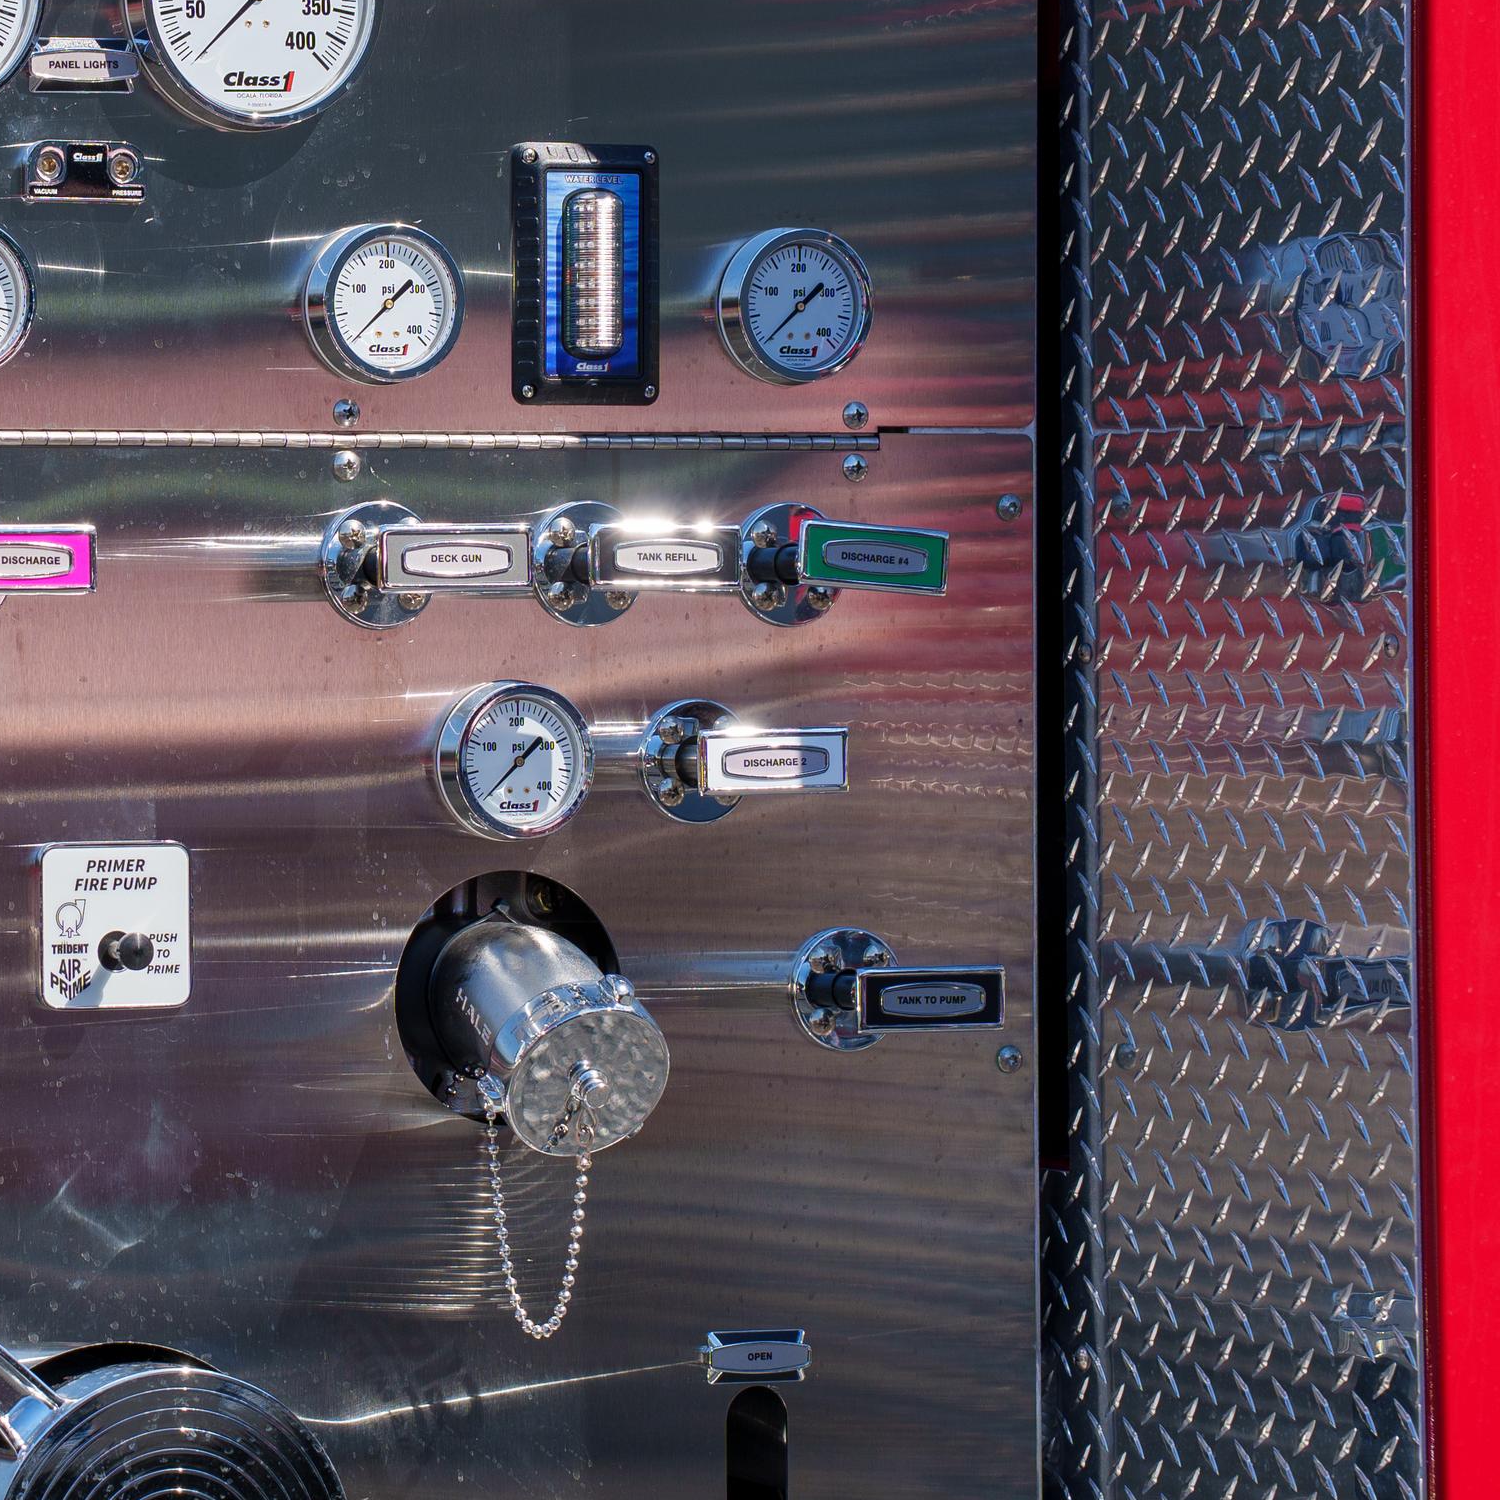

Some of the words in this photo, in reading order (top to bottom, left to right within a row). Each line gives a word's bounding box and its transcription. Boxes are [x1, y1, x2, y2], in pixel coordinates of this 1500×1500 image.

[185, 0, 205, 19] 50
[286, 31, 316, 50] 400
[49, 61, 80, 69] PANEL
[84, 61, 119, 69] LIGHTS
[224, 71, 295, 92] Class1
[565, 175, 594, 183] WATER
[596, 176, 622, 184] LEVEL
[379, 260, 395, 269] 200
[791, 263, 806, 273] 200
[352, 284, 366, 293] 100
[382, 284, 395, 296] psi
[764, 287, 778, 296] 100
[407, 325, 422, 335] 400
[816, 328, 831, 337] 400
[369, 344, 409, 356] Class1
[780, 346, 818, 358] Class1
[576, 362, 609, 372] Class1
[2, 556, 60, 565] DISCHARGE
[431, 555, 458, 563] DECK
[461, 555, 482, 563] GUN
[637, 553, 662, 561] TANK
[665, 553, 697, 562] REFILL
[842, 552, 895, 564] DISCHARGE
[509, 717, 525, 727] 200
[482, 742, 497, 751] 100
[512, 741, 525, 753] psi
[744, 758, 798, 767] DISCHARGE
[537, 781, 552, 791] 400
[500, 800, 539, 813] Class1
[86, 859, 145, 873] PRIMER
[75, 878, 108, 891] FIRE
[113, 877, 157, 891] PUMP
[149, 933, 177, 943] PUSH
[52, 944, 89, 955] TRIDENT
[157, 949, 170, 958] TO
[59, 959, 81, 981] AIR
[147, 964, 180, 974] PRIME
[50, 970, 91, 1001] PRIME
[897, 996, 921, 1005] TANK
[925, 996, 936, 1004] TO
[940, 996, 966, 1004] PUMP
[456, 987, 492, 1046] HALE
[748, 1352, 773, 1361] OPEN
